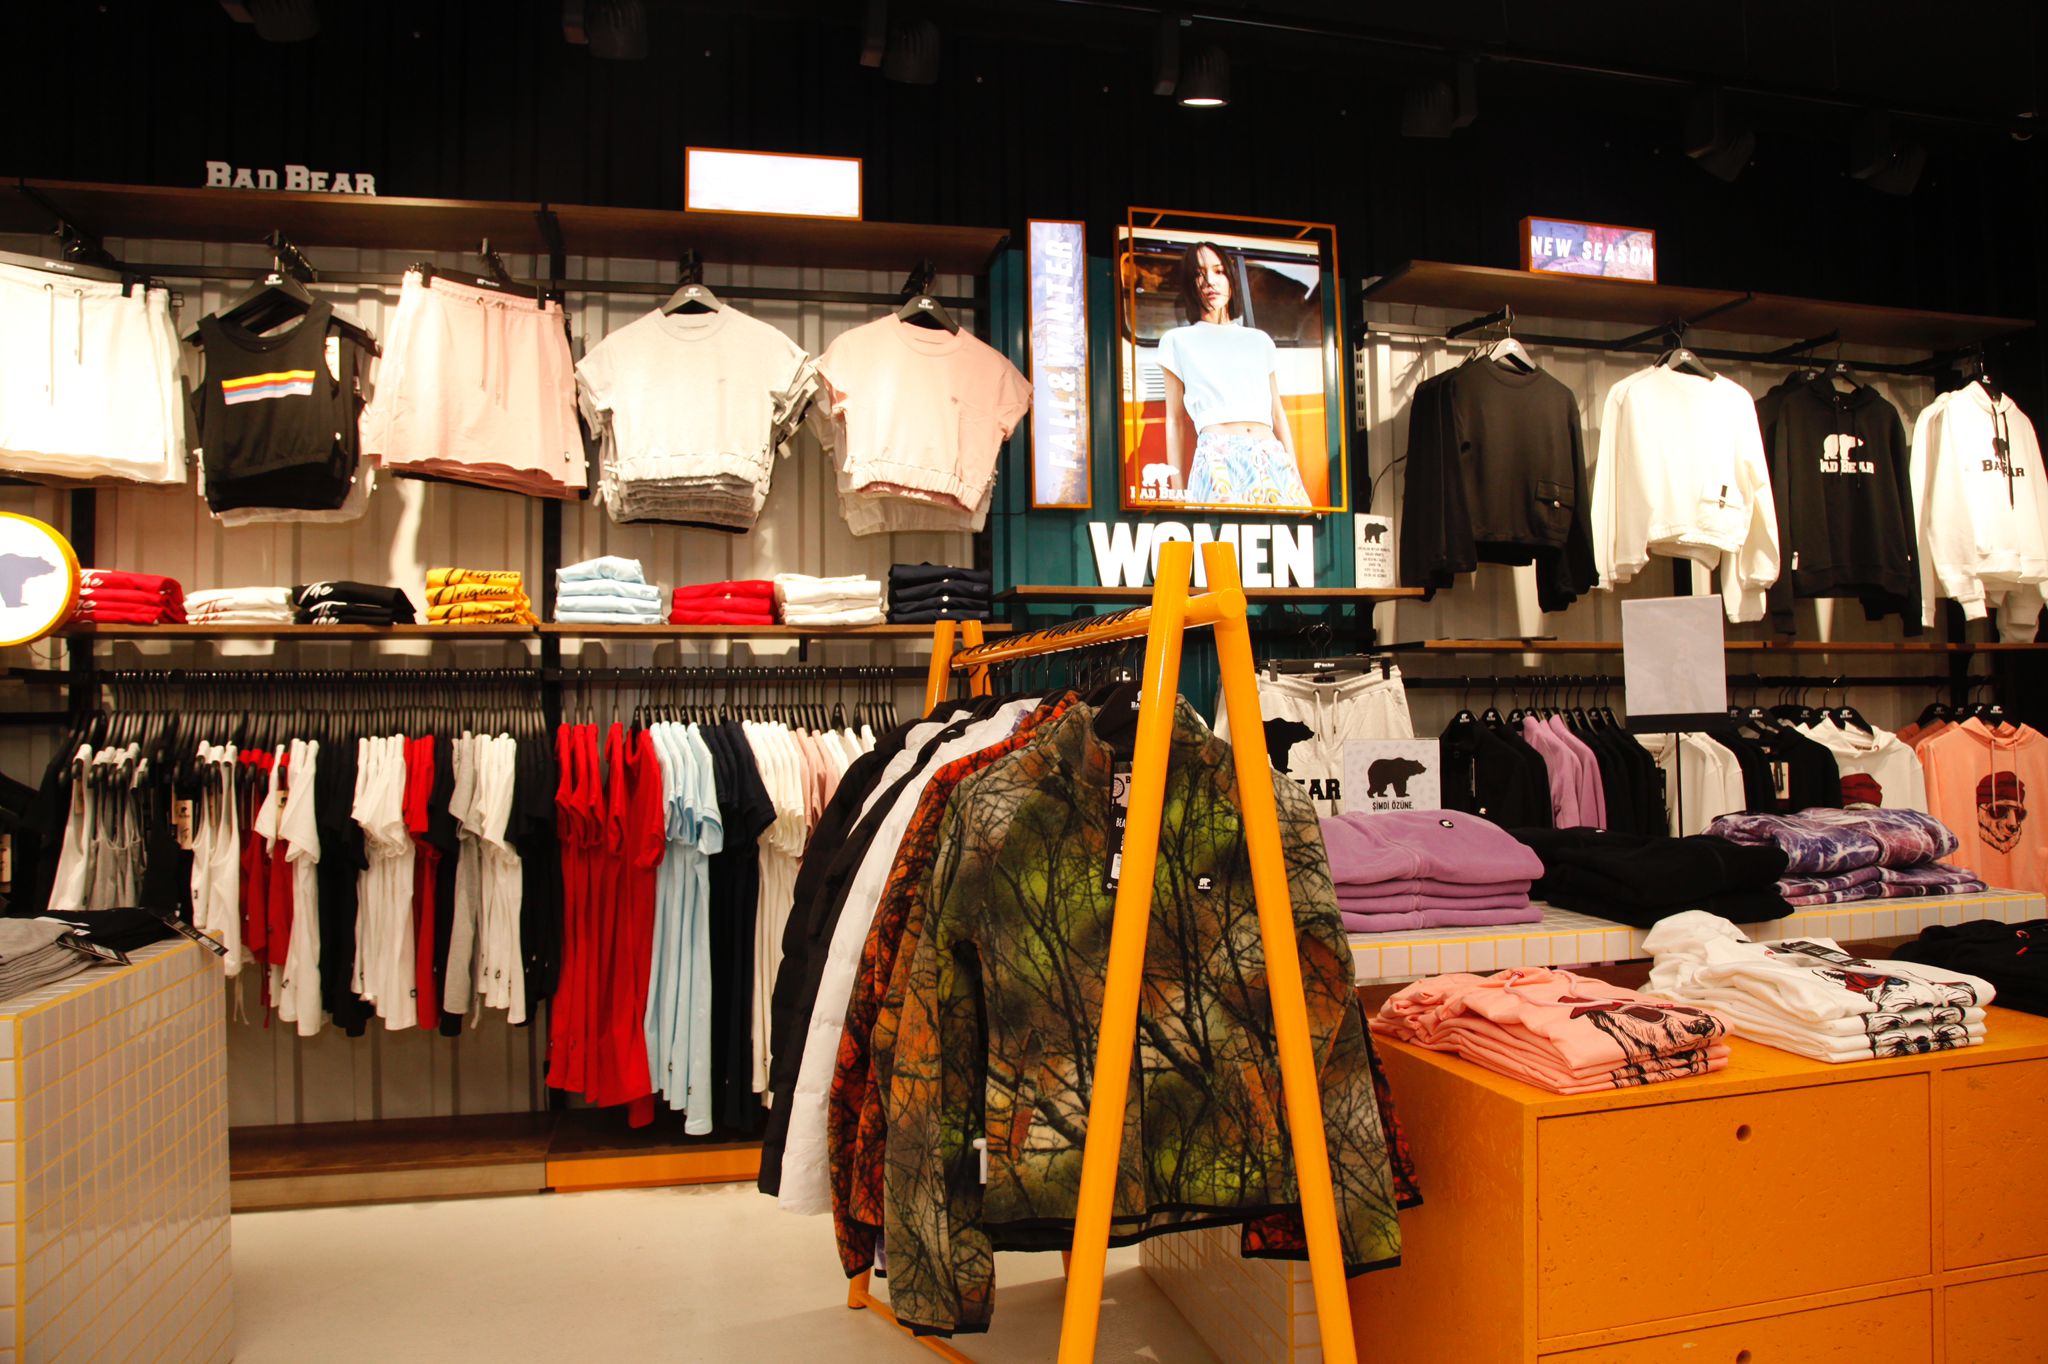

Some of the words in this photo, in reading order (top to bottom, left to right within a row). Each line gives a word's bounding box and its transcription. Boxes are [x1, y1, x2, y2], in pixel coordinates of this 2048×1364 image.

[206, 161, 278, 190] BAD
[285, 165, 376, 196] BEAR
[1531, 235, 1572, 258] NEW
[1582, 240, 1654, 267] SEASON
[1045, 239, 1076, 367] WINTER
[1047, 371, 1077, 392] &
[1049, 397, 1077, 470] FALL
